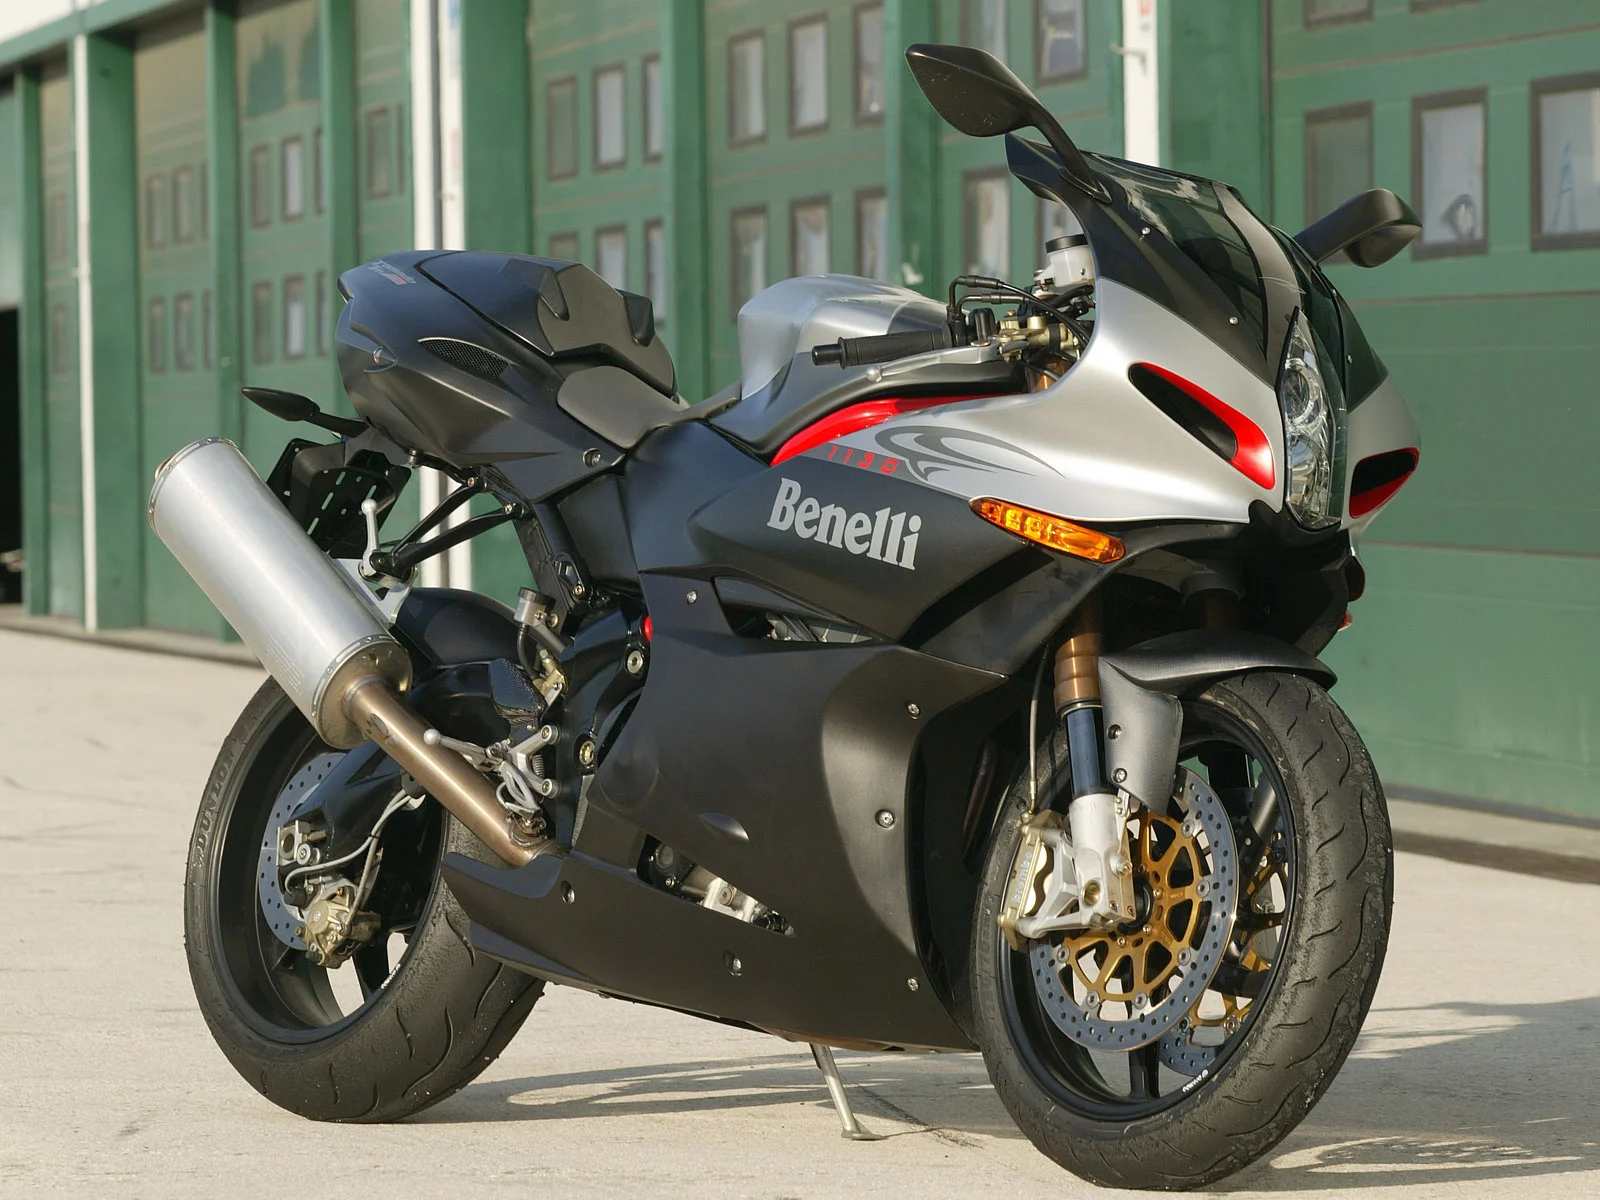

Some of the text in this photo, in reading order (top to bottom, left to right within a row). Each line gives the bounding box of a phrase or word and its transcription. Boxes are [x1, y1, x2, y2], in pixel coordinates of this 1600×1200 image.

[828, 446, 899, 474] 1130
[767, 478, 922, 570] Benelli
[1012, 851, 1032, 904] brembo
